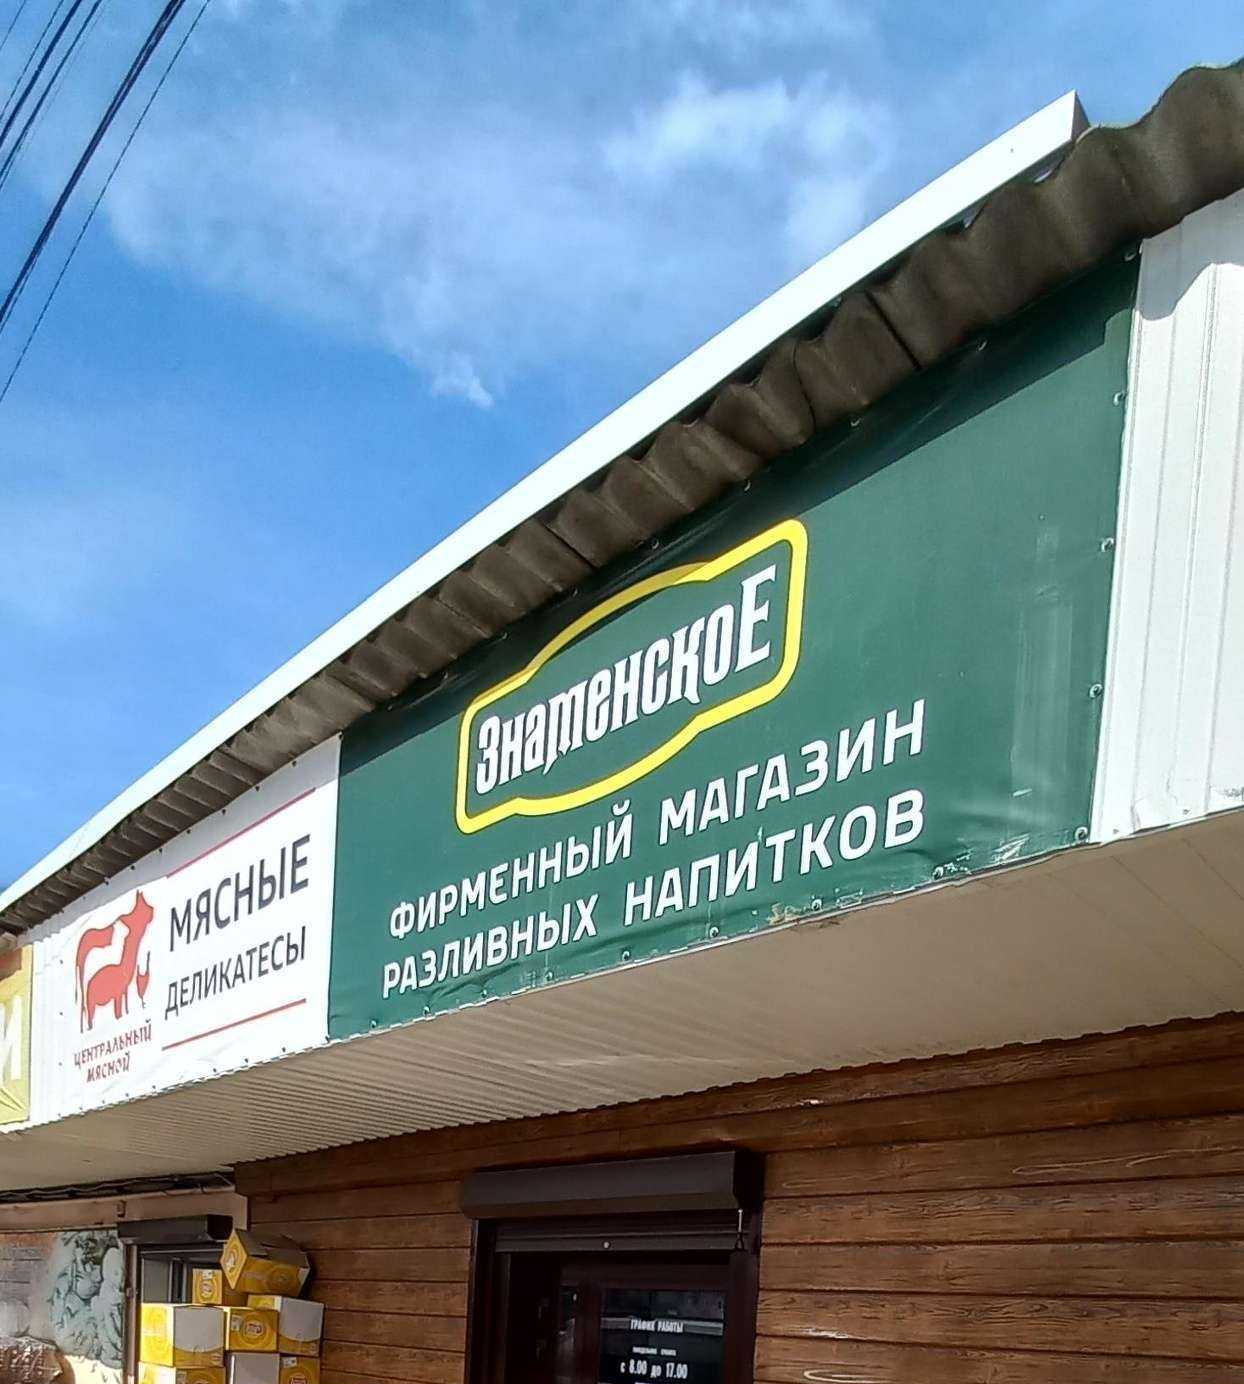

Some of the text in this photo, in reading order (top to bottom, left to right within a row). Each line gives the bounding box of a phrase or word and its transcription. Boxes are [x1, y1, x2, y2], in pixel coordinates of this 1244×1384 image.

[388, 699, 926, 939] ФИРМЕННЫЙ МАГАЗИН
[169, 833, 311, 952] МЯСНЫЕ
[382, 789, 925, 998] РАЗЛИВНЫХ НАПИТКОВ
[164, 925, 307, 1020] ДЕЛИКАТЕСЫ
[74, 1018, 152, 1070] ЦЕНТРАЛЬНЫЙ
[86, 1051, 131, 1083] МЯСНОЙ
[629, 1359, 648, 1375] 8.00
[666, 1362, 688, 1379] 17.00
